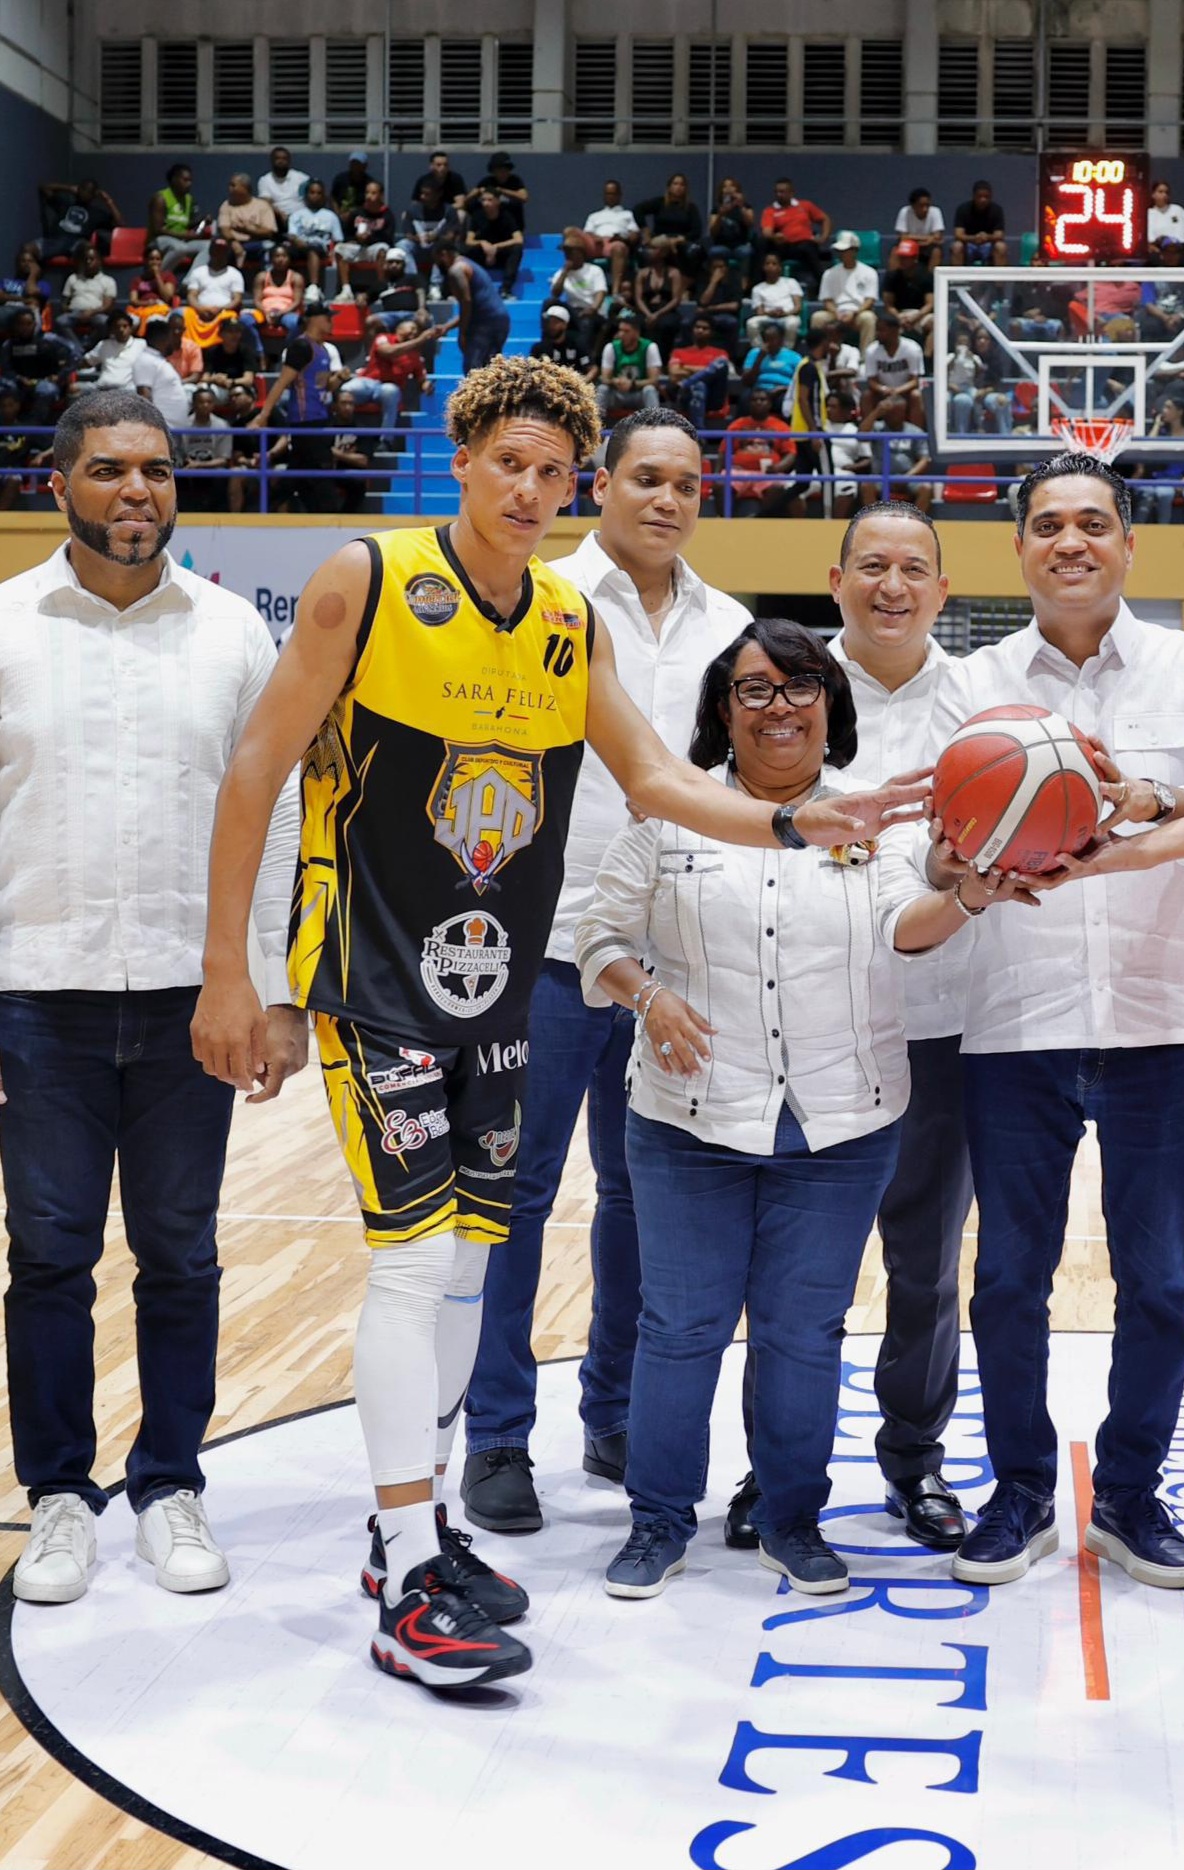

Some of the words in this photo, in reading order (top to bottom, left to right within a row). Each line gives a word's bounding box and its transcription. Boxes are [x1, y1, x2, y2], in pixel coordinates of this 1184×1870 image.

[1072, 160, 1125, 183] 10:00
[1055, 184, 1134, 254] 24
[543, 633, 574, 677] 10
[442, 682, 494, 701] SARA
[506, 688, 557, 711] FELIZ
[471, 723, 528, 736] BARAHONA
[433, 766, 537, 859] JPD
[426, 940, 509, 960] RESTAURANTE
